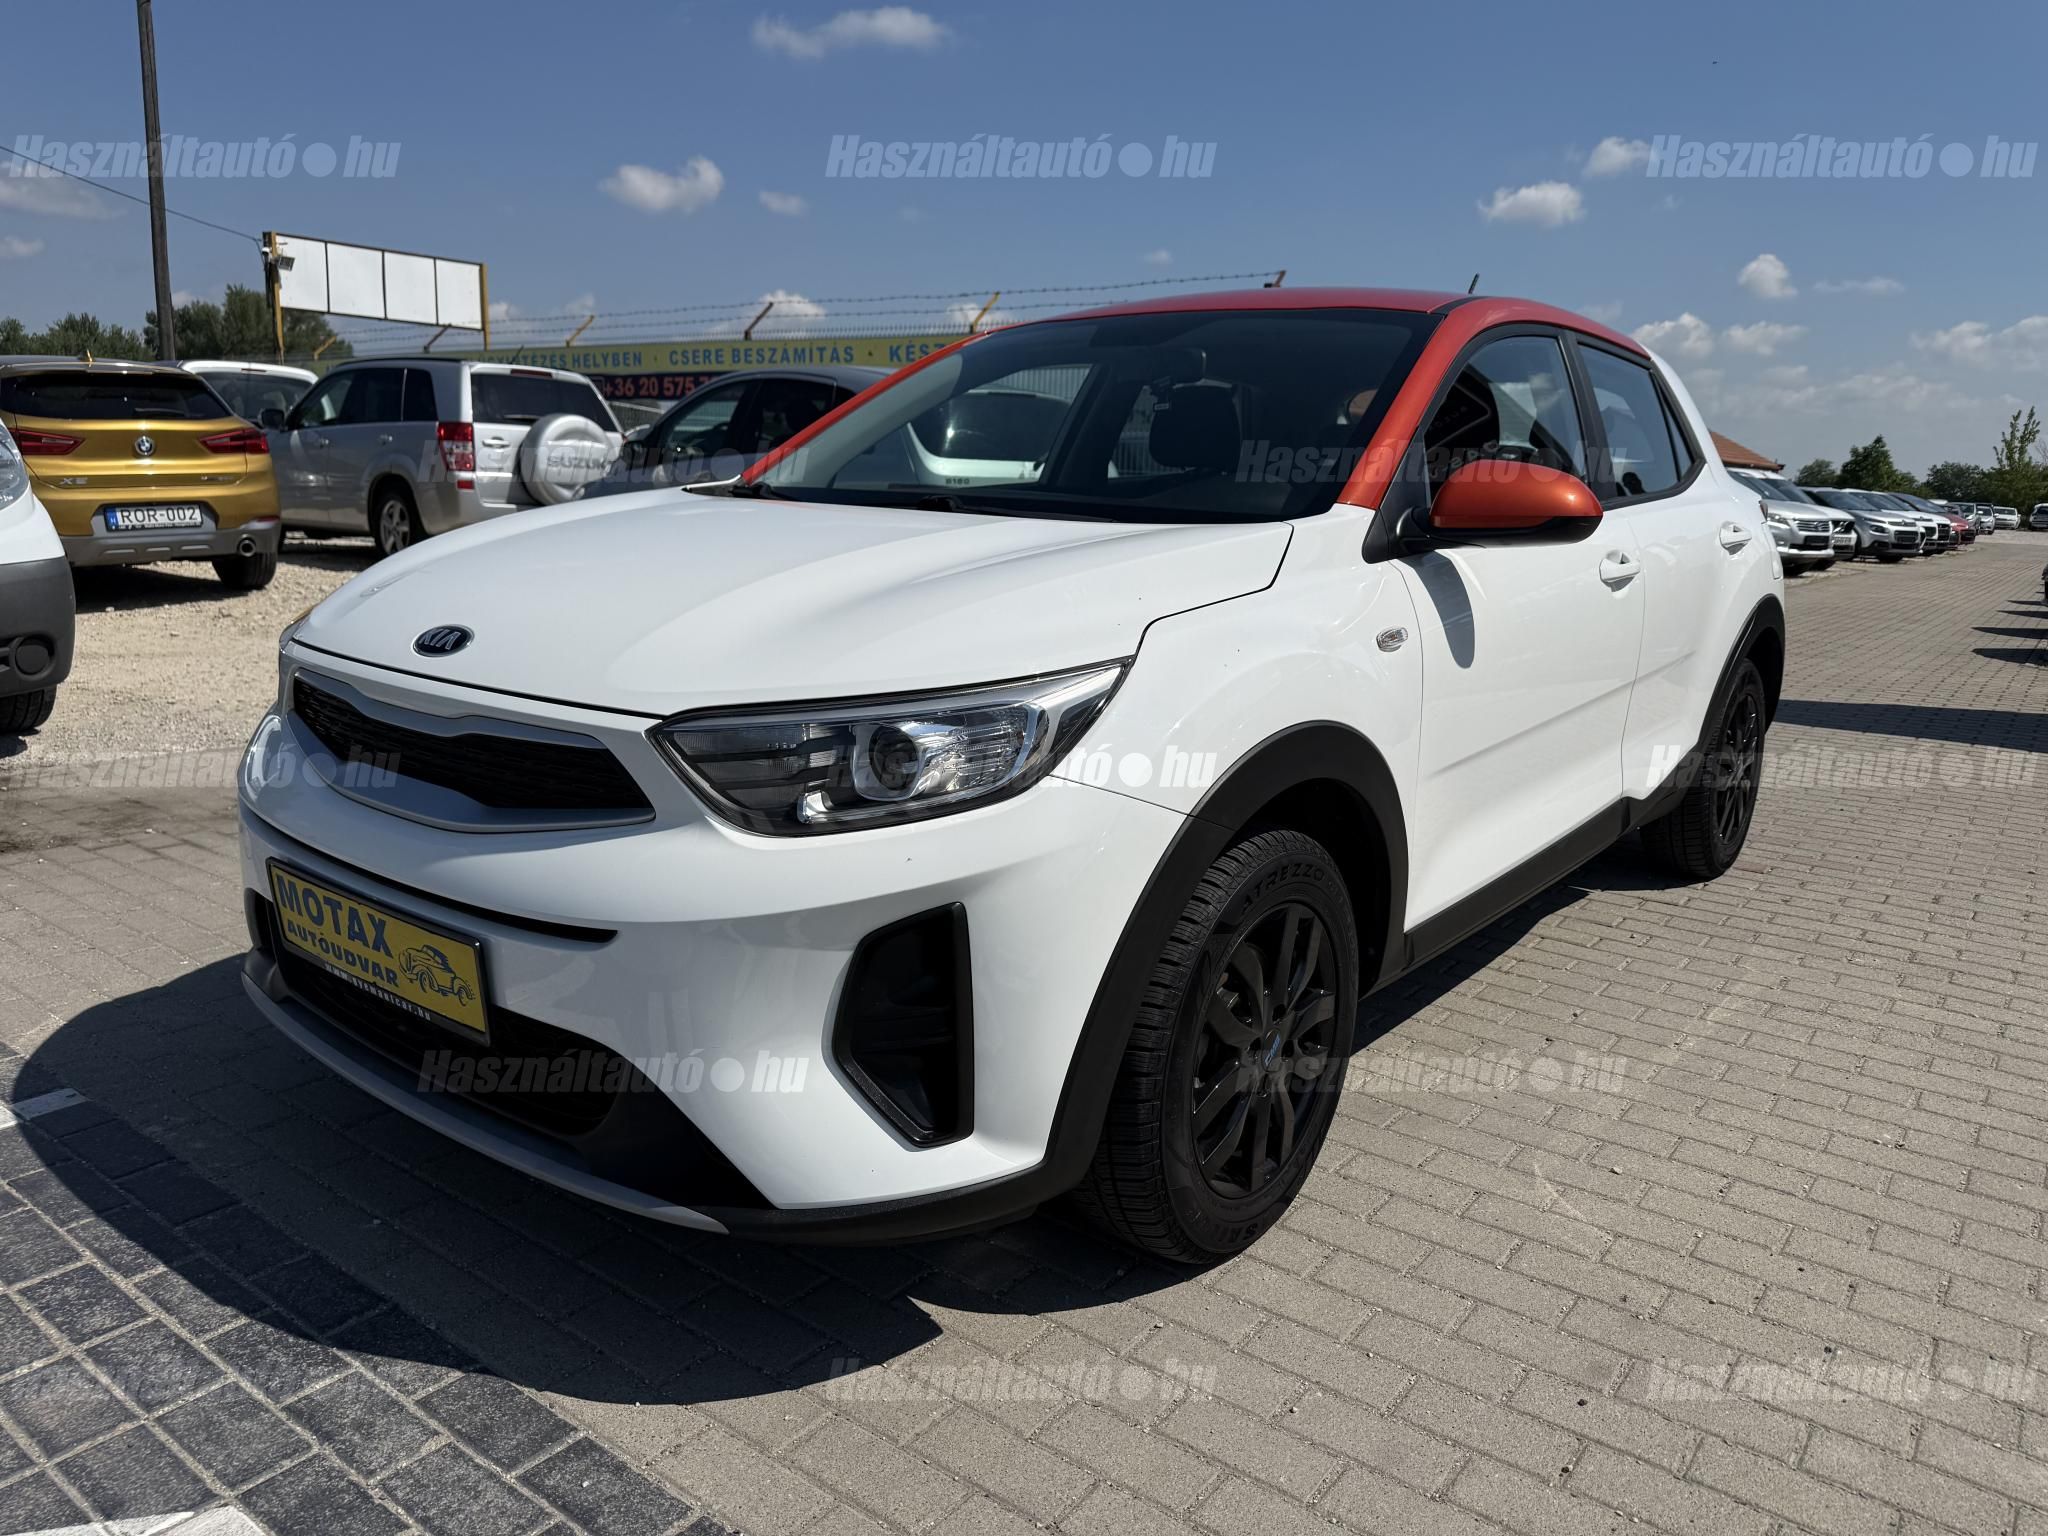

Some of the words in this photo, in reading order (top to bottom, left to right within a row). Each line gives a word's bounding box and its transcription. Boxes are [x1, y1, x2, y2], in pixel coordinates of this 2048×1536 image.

[572, 351, 642, 368] HELYBEN
[669, 346, 724, 366] CSERE
[732, 341, 854, 364] BESZÁMÍTÁS
[888, 342, 946, 362] KÉS
[639, 377, 658, 396] 20
[547, 456, 606, 470] SUZUK
[119, 507, 199, 524] ROR-002
[418, 628, 462, 651] KIA
[276, 873, 393, 960] MOTAX
[287, 918, 400, 988] AUTÓUDVAR
